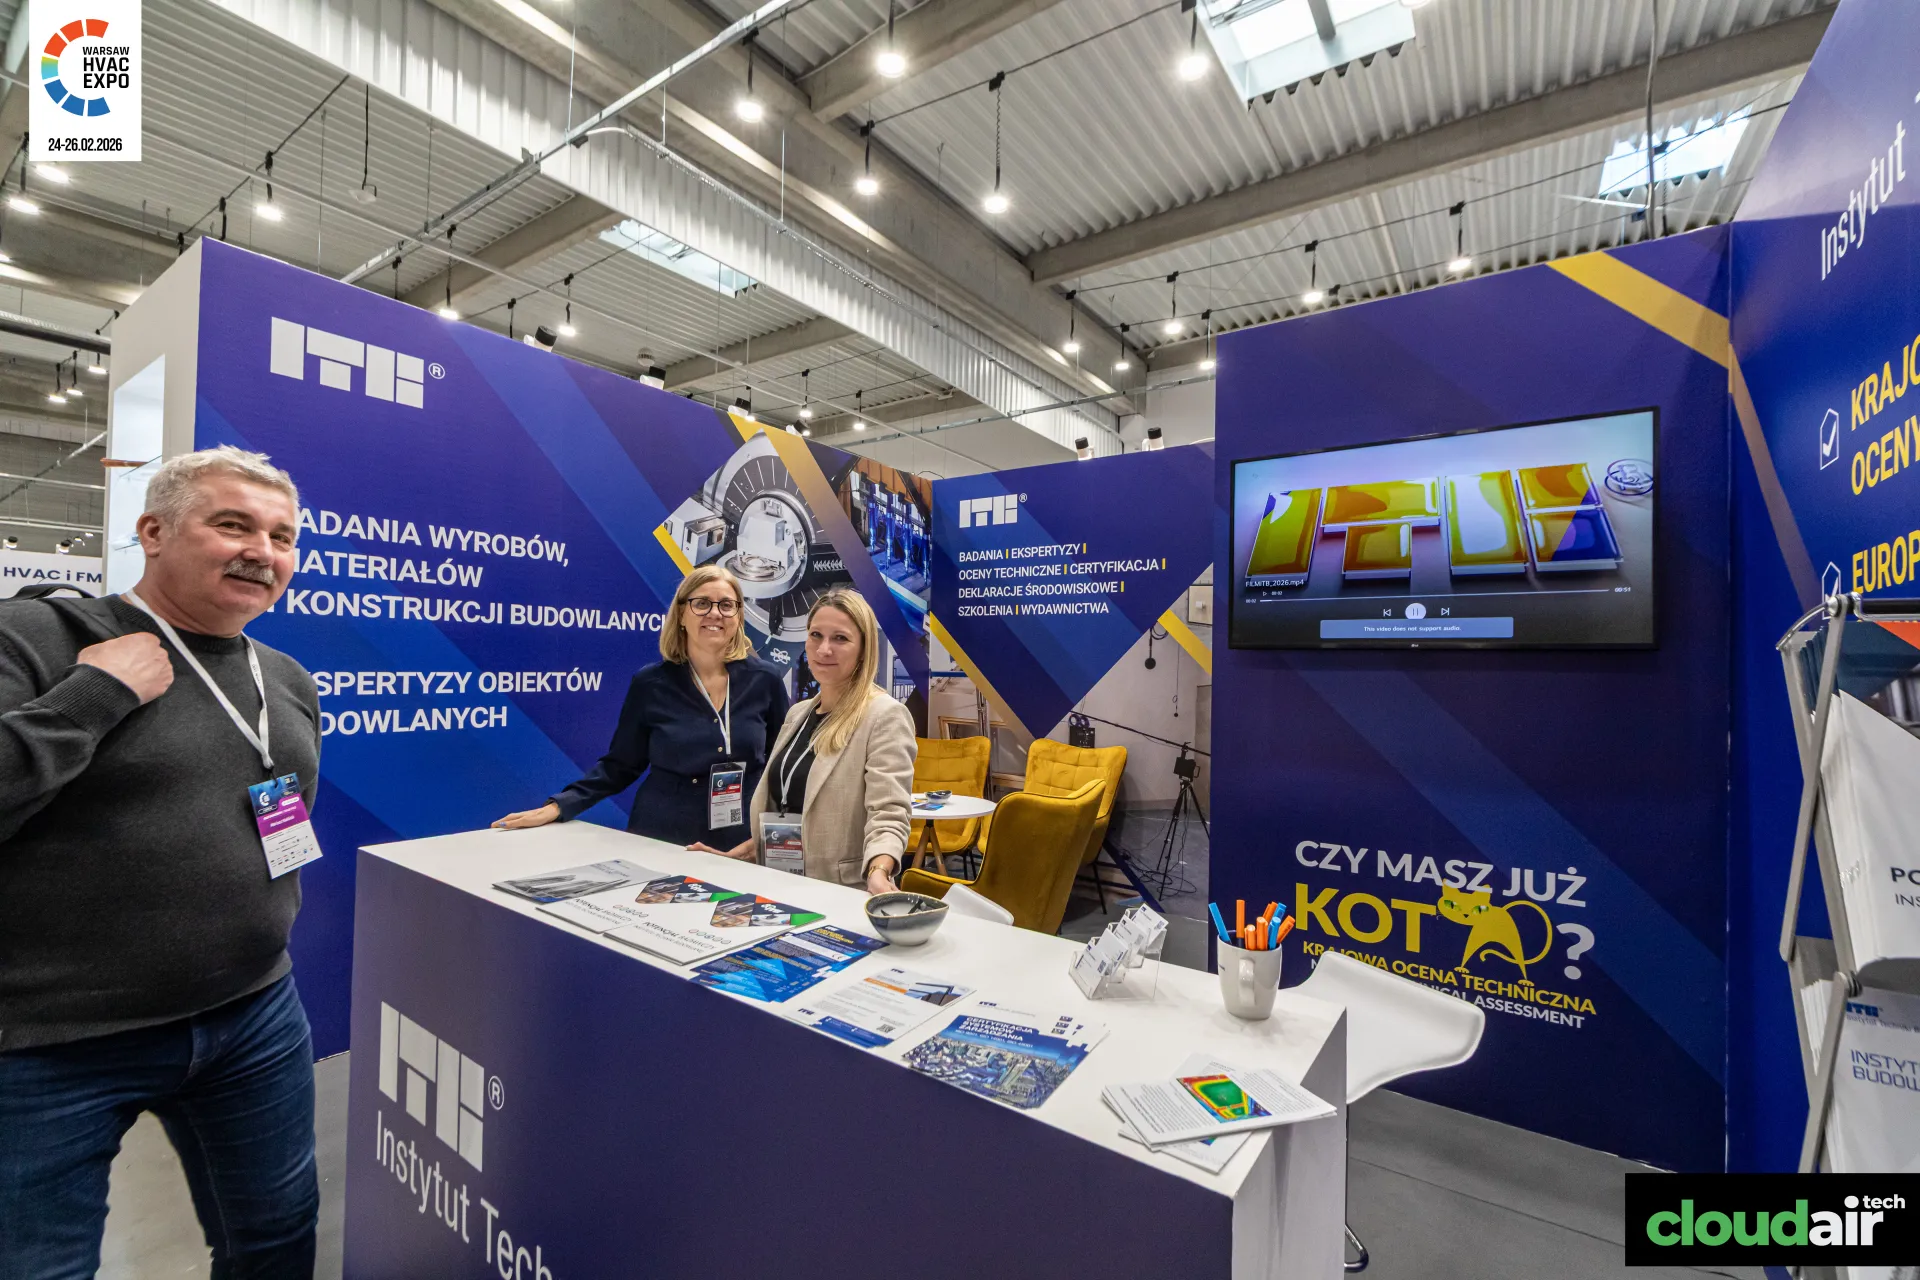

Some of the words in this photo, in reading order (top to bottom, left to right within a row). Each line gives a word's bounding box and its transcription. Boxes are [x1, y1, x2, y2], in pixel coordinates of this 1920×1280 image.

[1821, 119, 1906, 282] Instytut
[298, 507, 422, 546] ADANIA
[428, 524, 570, 567] WYROBÓW,
[958, 549, 1004, 563] BADANIA
[1010, 543, 1081, 559] EKSPERTYZY
[3, 566, 61, 580] HVAC
[66, 570, 71, 581] i
[75, 572, 103, 584] FM
[958, 569, 993, 580] OCENY
[995, 564, 1062, 579] TECHNICZNE
[1069, 558, 1159, 576] CERTYFIKACJA
[1852, 529, 1920, 595] EUROP
[286, 588, 503, 624] KONSTRUKCJI
[958, 586, 1023, 599] DEKLARACJE
[1025, 581, 1119, 596] ŚRODOWISKOWE
[957, 604, 1013, 617] SZKOLENIA
[1021, 602, 1110, 616] WYDAWNICTWA
[1418, 625, 1442, 633] support
[478, 667, 603, 693] OBIEKTÓW
[1295, 840, 1369, 874] CZY
[1377, 850, 1494, 894] MASZ
[1502, 866, 1588, 908] JUŻ
[1295, 882, 1437, 954] KOT
[1556, 922, 1596, 981] ?
[1391, 960, 1459, 987] OCENA
[1461, 973, 1598, 1016] TECHNICZNA
[1473, 994, 1586, 1029] ASSESSMENT
[376, 1110, 470, 1244] Instytut
